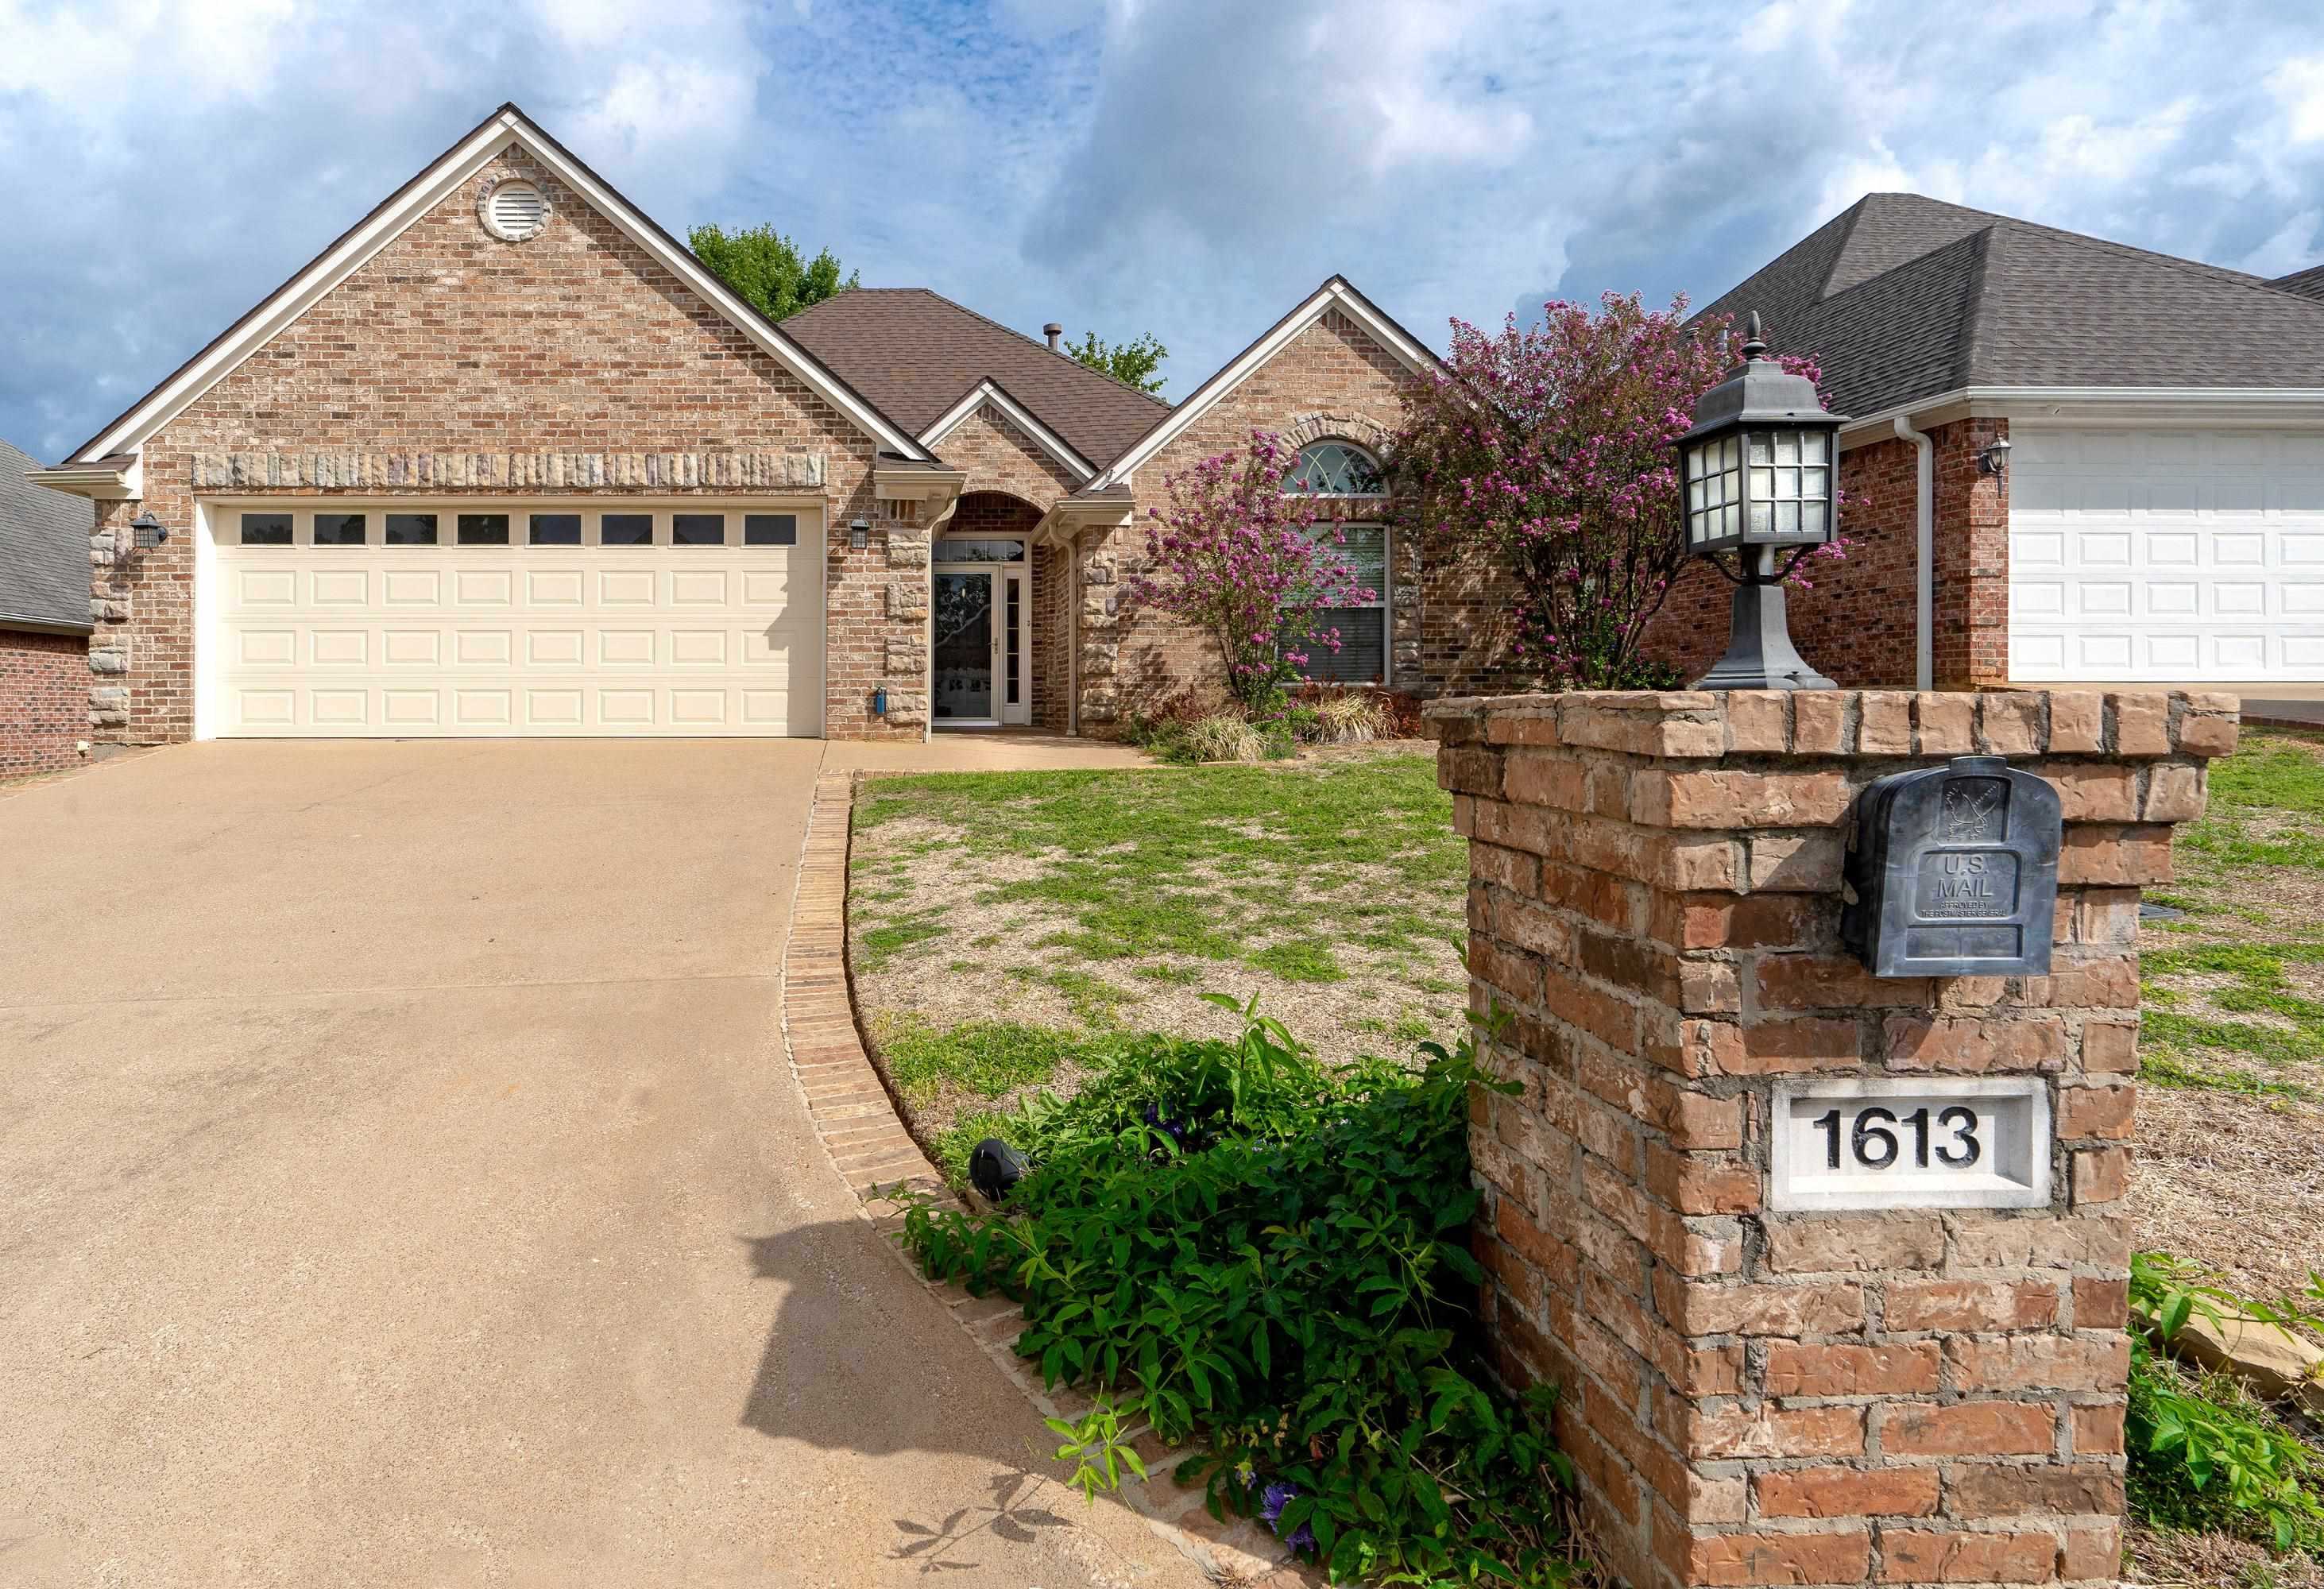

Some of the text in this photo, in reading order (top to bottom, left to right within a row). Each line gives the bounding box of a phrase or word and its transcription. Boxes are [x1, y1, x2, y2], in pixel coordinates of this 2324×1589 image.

[1944, 854, 1990, 875] U.S.
[1937, 877, 1993, 897] MAIL
[1813, 1106, 1981, 1170] 1613
